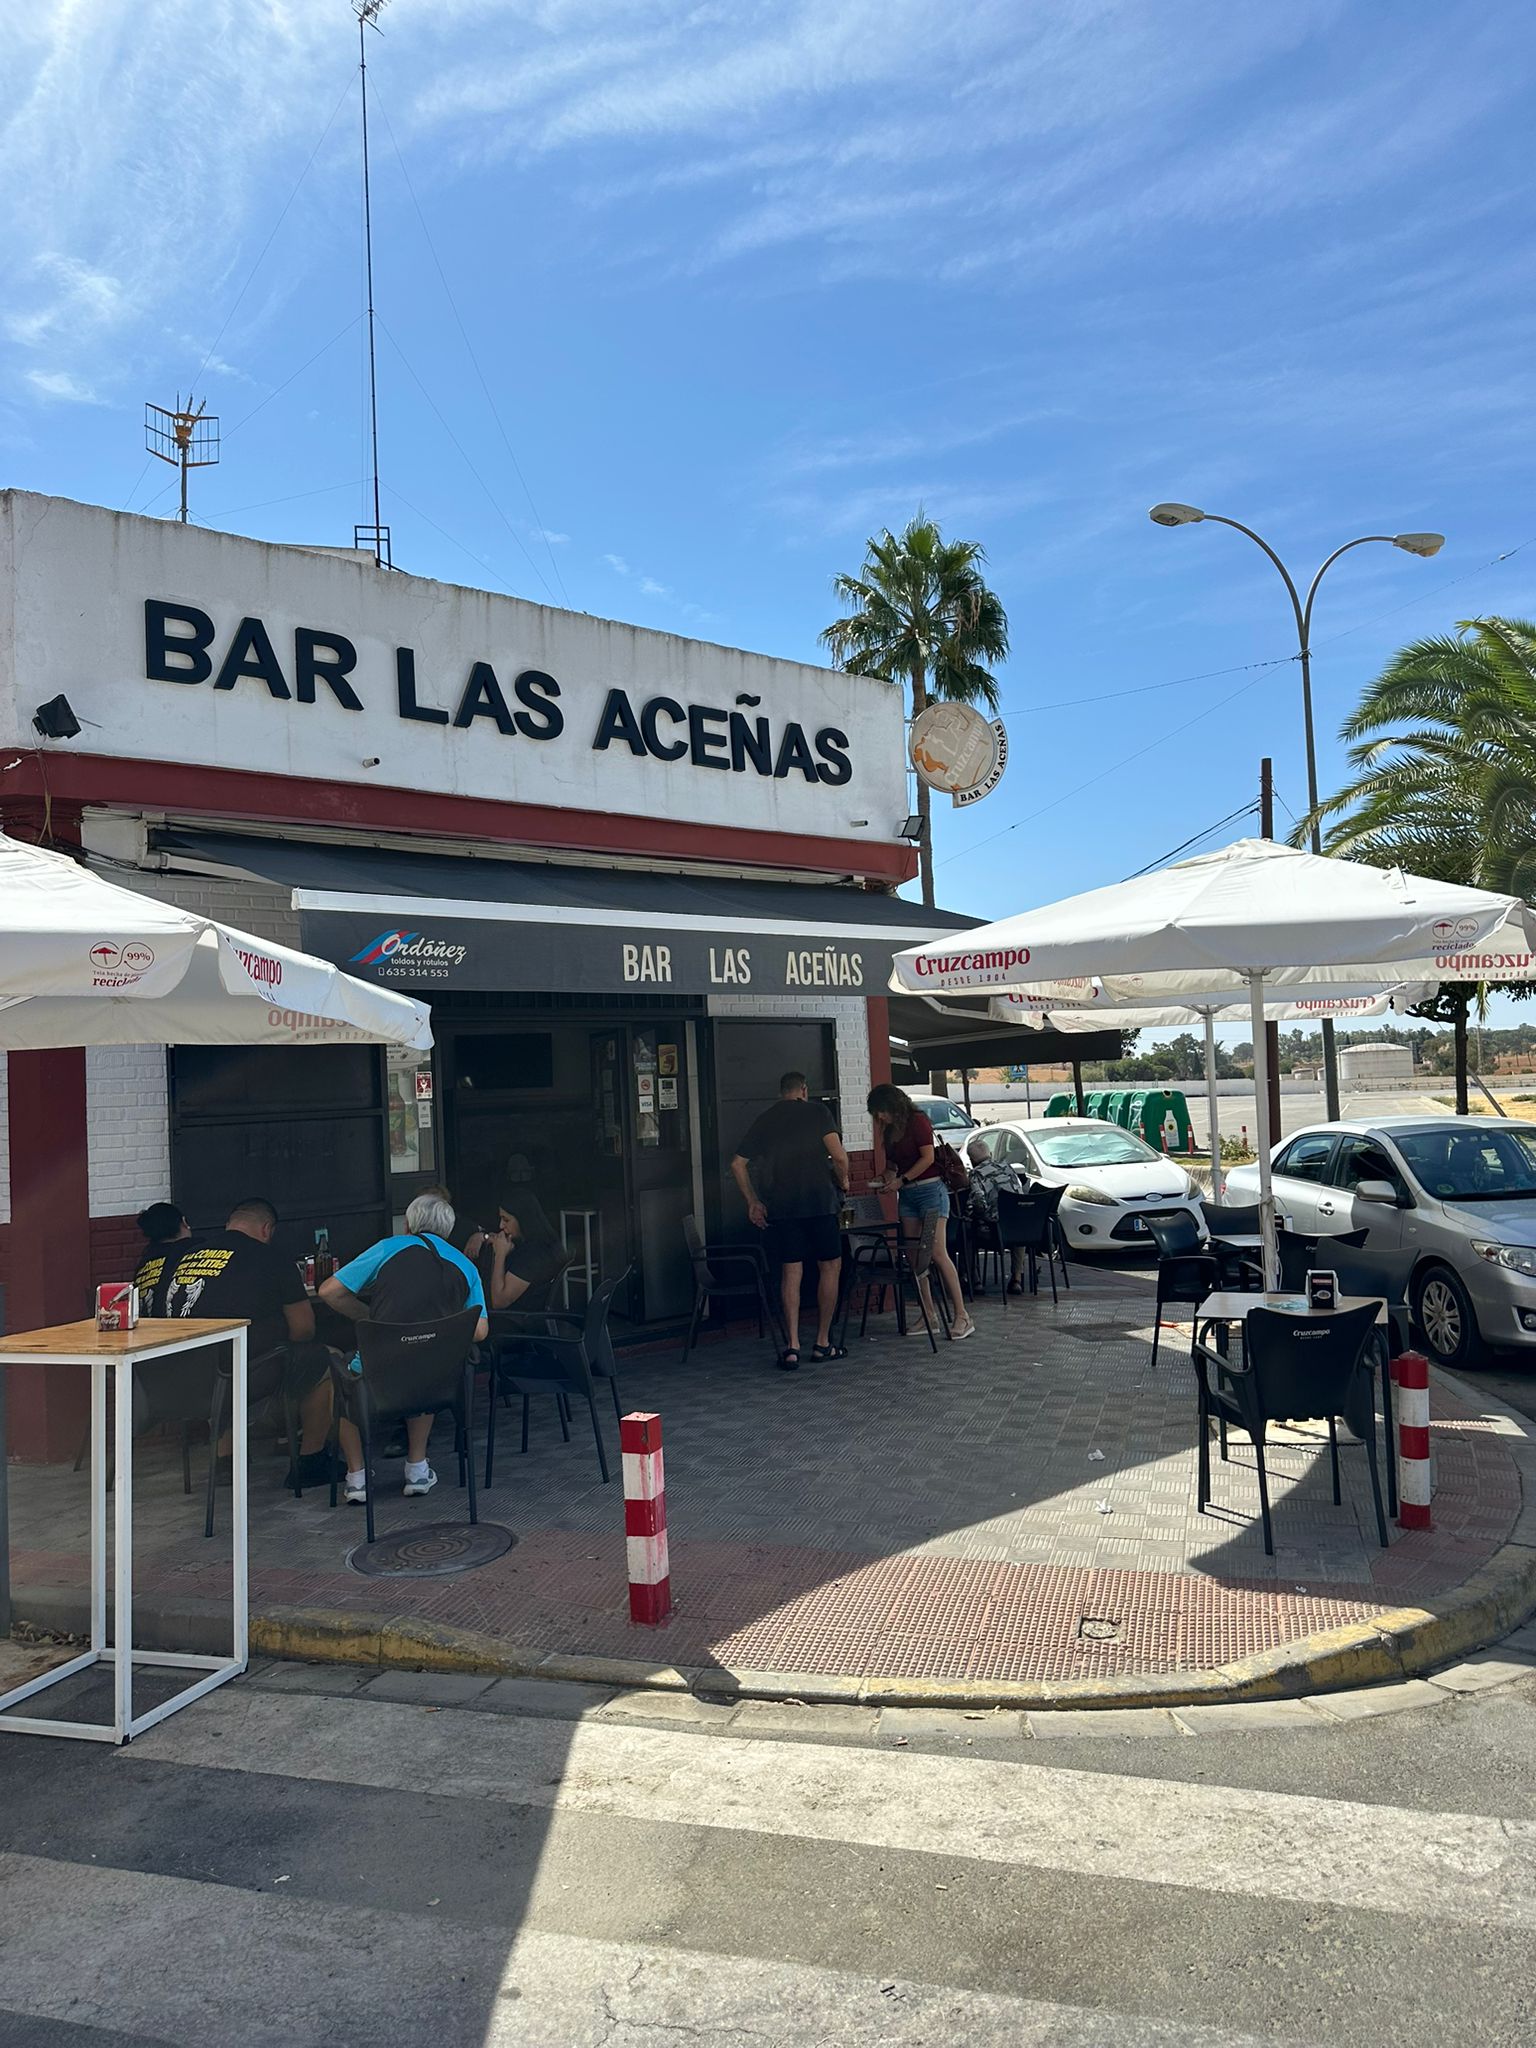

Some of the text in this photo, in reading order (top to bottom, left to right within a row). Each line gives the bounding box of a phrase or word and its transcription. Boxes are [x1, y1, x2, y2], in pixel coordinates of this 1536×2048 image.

[145, 598, 853, 786] BAR LAS ACEÑAS
[960, 724, 1007, 802] BAR LAS ACEÑAS
[126, 952, 151, 961] 99%
[391, 957, 449, 967] toldos y rótulos
[622, 944, 863, 987] BAR LAS ACEÑAS
[915, 948, 1030, 977] Cruzcampo
[386, 967, 449, 978] 635 314 553
[1293, 1329, 1331, 1337] Cruzcampo
